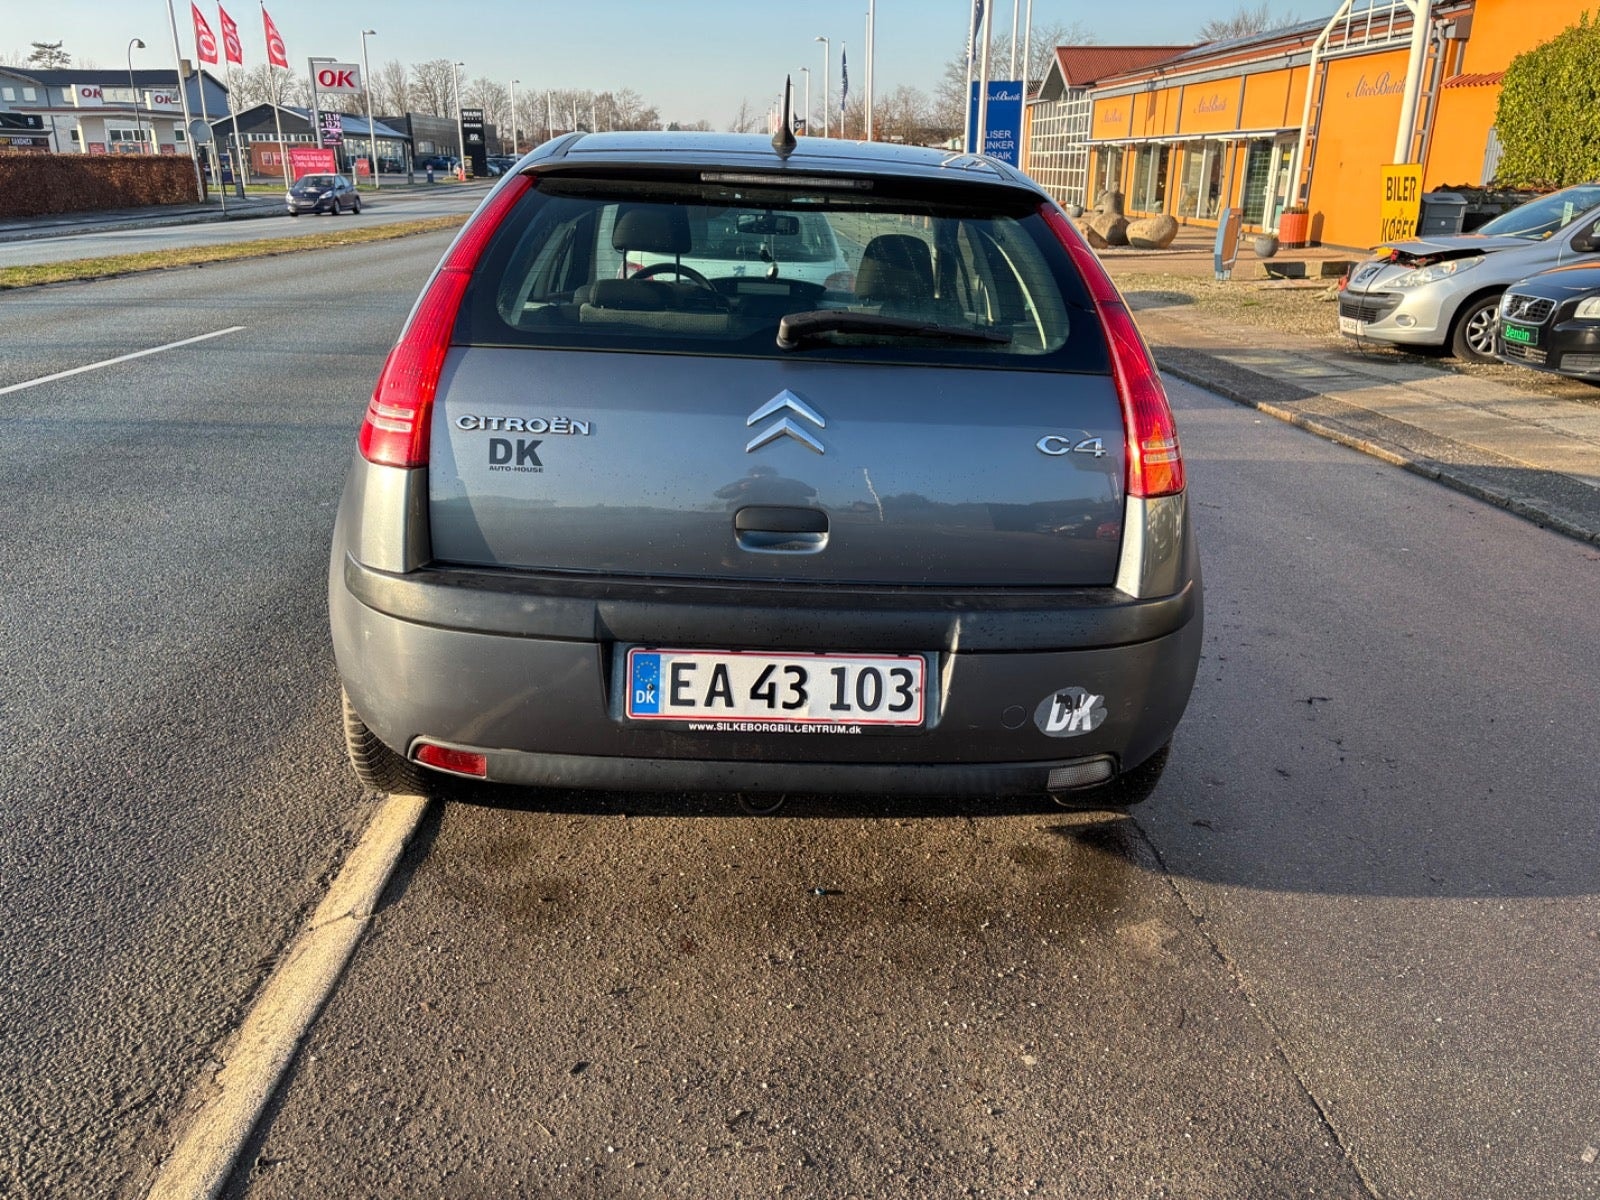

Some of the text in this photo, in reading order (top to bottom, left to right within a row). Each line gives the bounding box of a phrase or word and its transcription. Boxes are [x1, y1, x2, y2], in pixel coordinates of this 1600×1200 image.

[317, 69, 356, 88] OK
[81, 87, 103, 99] OK
[154, 94, 174, 104] OK
[985, 129, 1012, 139] LISER
[984, 140, 1015, 149] INKER
[985, 150, 1012, 160] OSAIK
[1386, 176, 1417, 202] BILER
[1505, 324, 1531, 341] Benzin
[455, 413, 591, 436] CITROËN
[489, 438, 544, 467] DK
[1036, 435, 1107, 458] C4
[669, 661, 914, 712] EA 43 103
[635, 689, 656, 704] DK
[1045, 693, 1100, 731] DK
